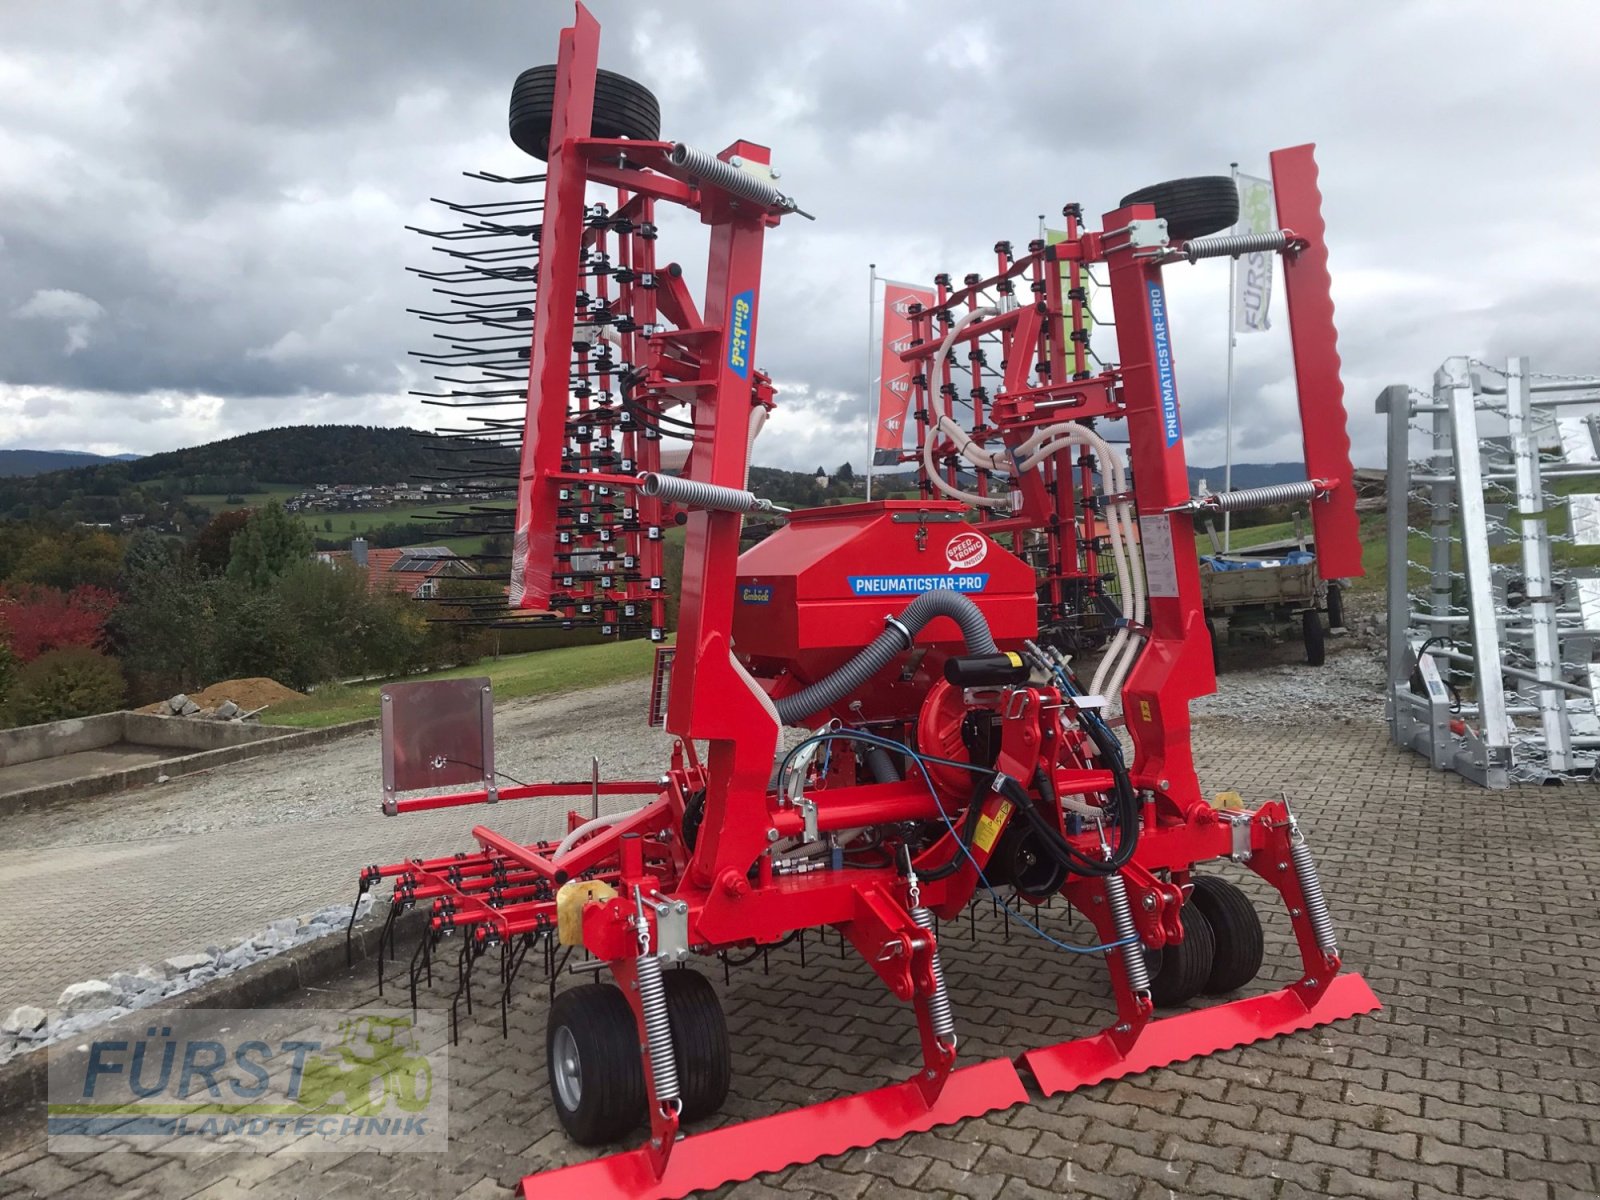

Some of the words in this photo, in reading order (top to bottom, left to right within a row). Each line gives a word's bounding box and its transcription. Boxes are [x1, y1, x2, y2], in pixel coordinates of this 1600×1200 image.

[1244, 227, 1265, 330] FÜRS
[731, 299, 749, 367] Einböck
[1150, 288, 1178, 438] PNEUMATICSTAR-PRO
[856, 577, 982, 592] PNEUMATICSTAR-PRO
[954, 541, 982, 561] TRONIC
